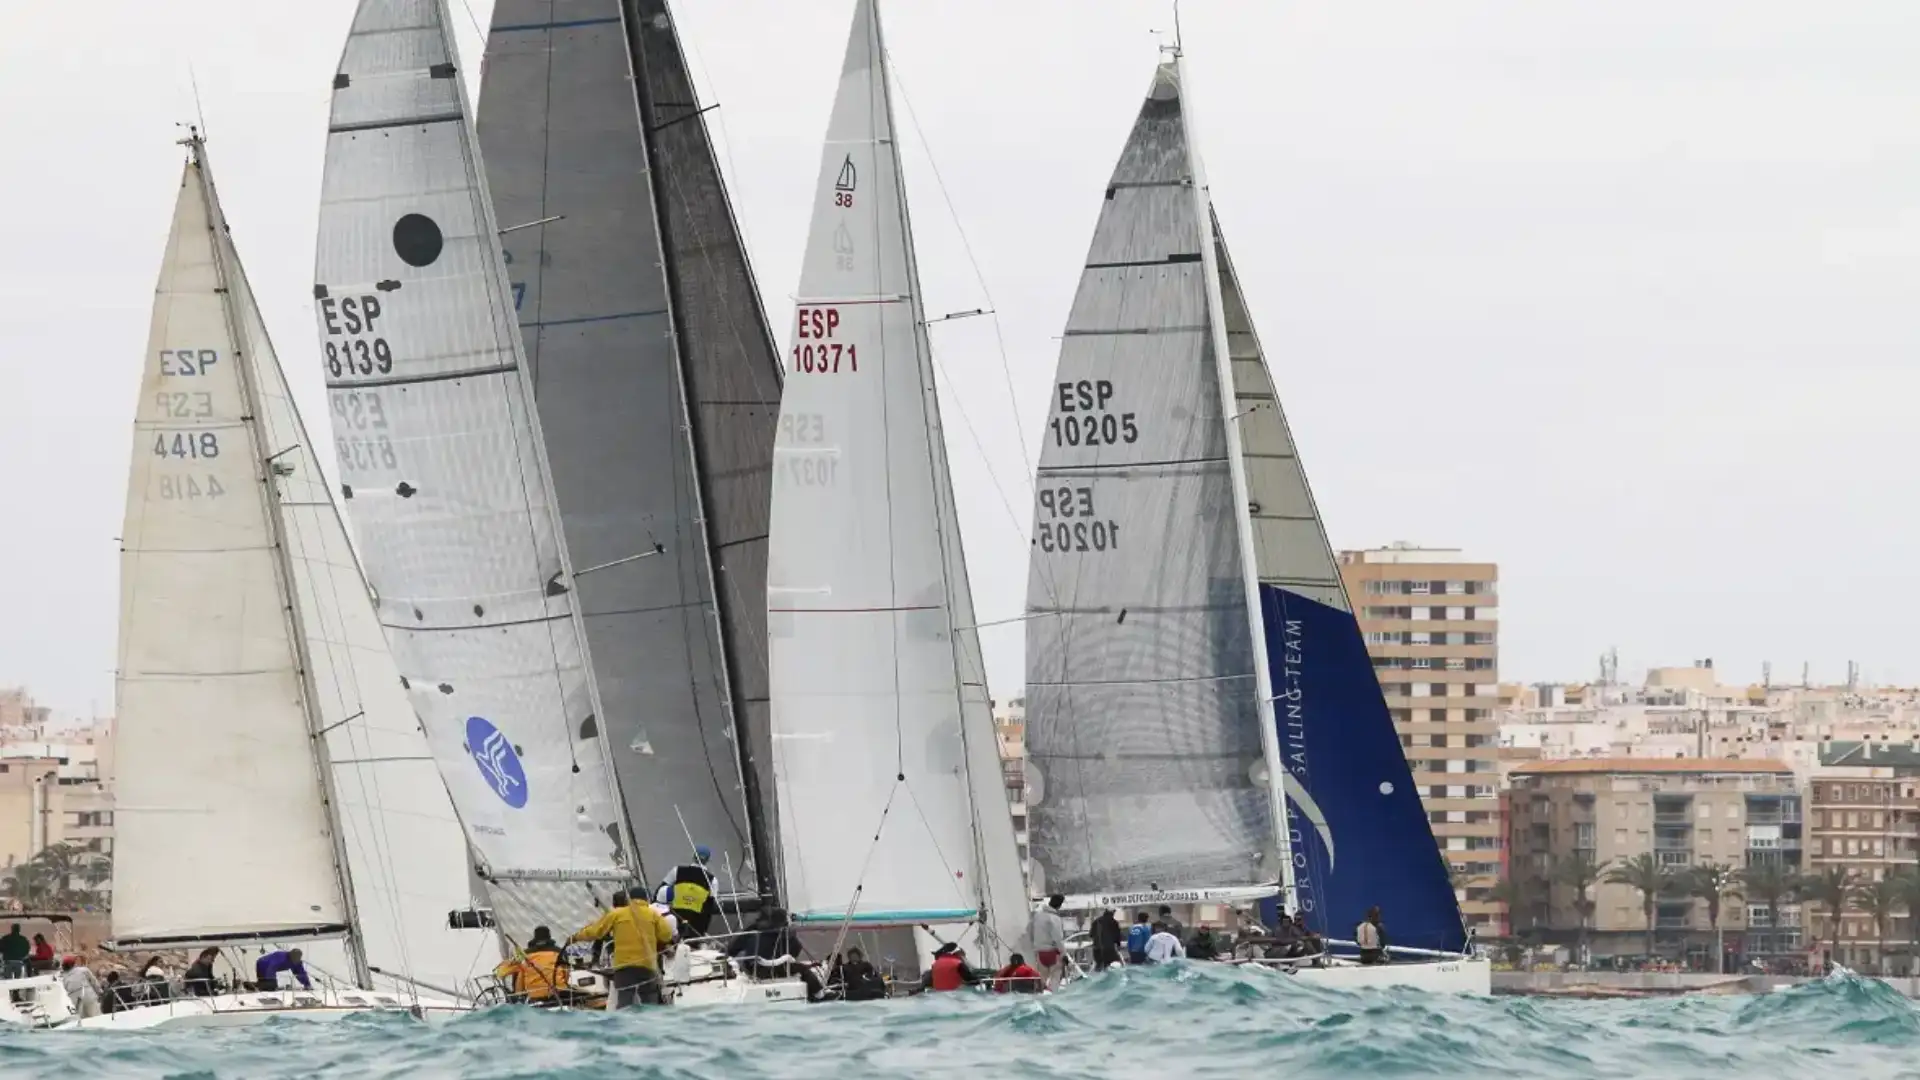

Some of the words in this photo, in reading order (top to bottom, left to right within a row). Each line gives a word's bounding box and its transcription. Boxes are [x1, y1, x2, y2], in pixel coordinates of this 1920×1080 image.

[835, 192, 853, 208] 38
[321, 295, 381, 335] ESP
[799, 309, 840, 339] ESP
[160, 349, 218, 376] ESP
[326, 338, 392, 378] 8139
[793, 344, 858, 373] 10371
[1059, 380, 1113, 412] ESP
[1051, 413, 1138, 447] 10205
[154, 432, 219, 459] 4418
